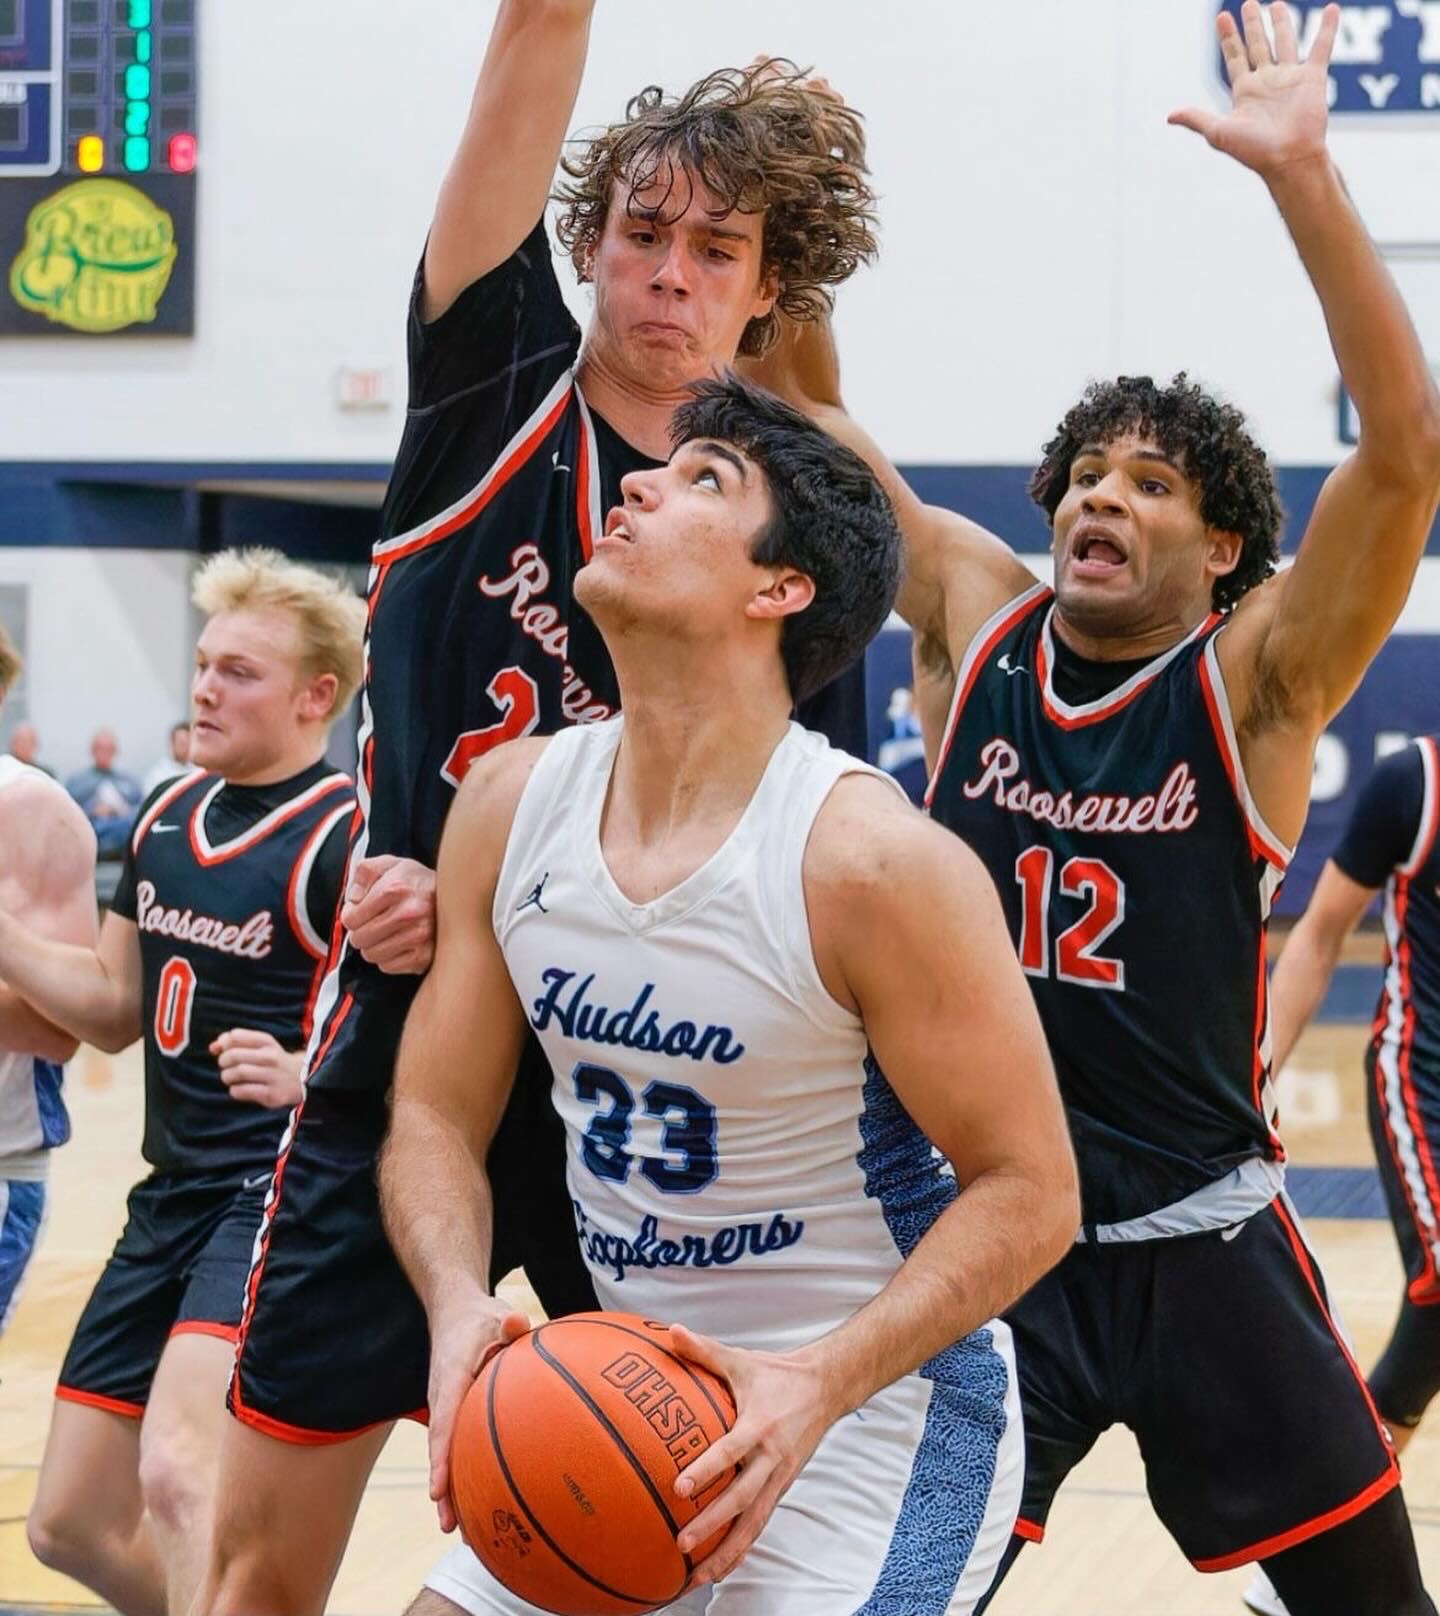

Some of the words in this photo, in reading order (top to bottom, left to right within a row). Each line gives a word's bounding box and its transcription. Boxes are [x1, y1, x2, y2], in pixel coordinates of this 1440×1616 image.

[963, 737, 1199, 832] Roosevelt
[136, 879, 273, 960] Roosevelt
[1014, 844, 1127, 992] 12
[154, 955, 198, 1060] 0
[531, 967, 746, 1065] Hudson
